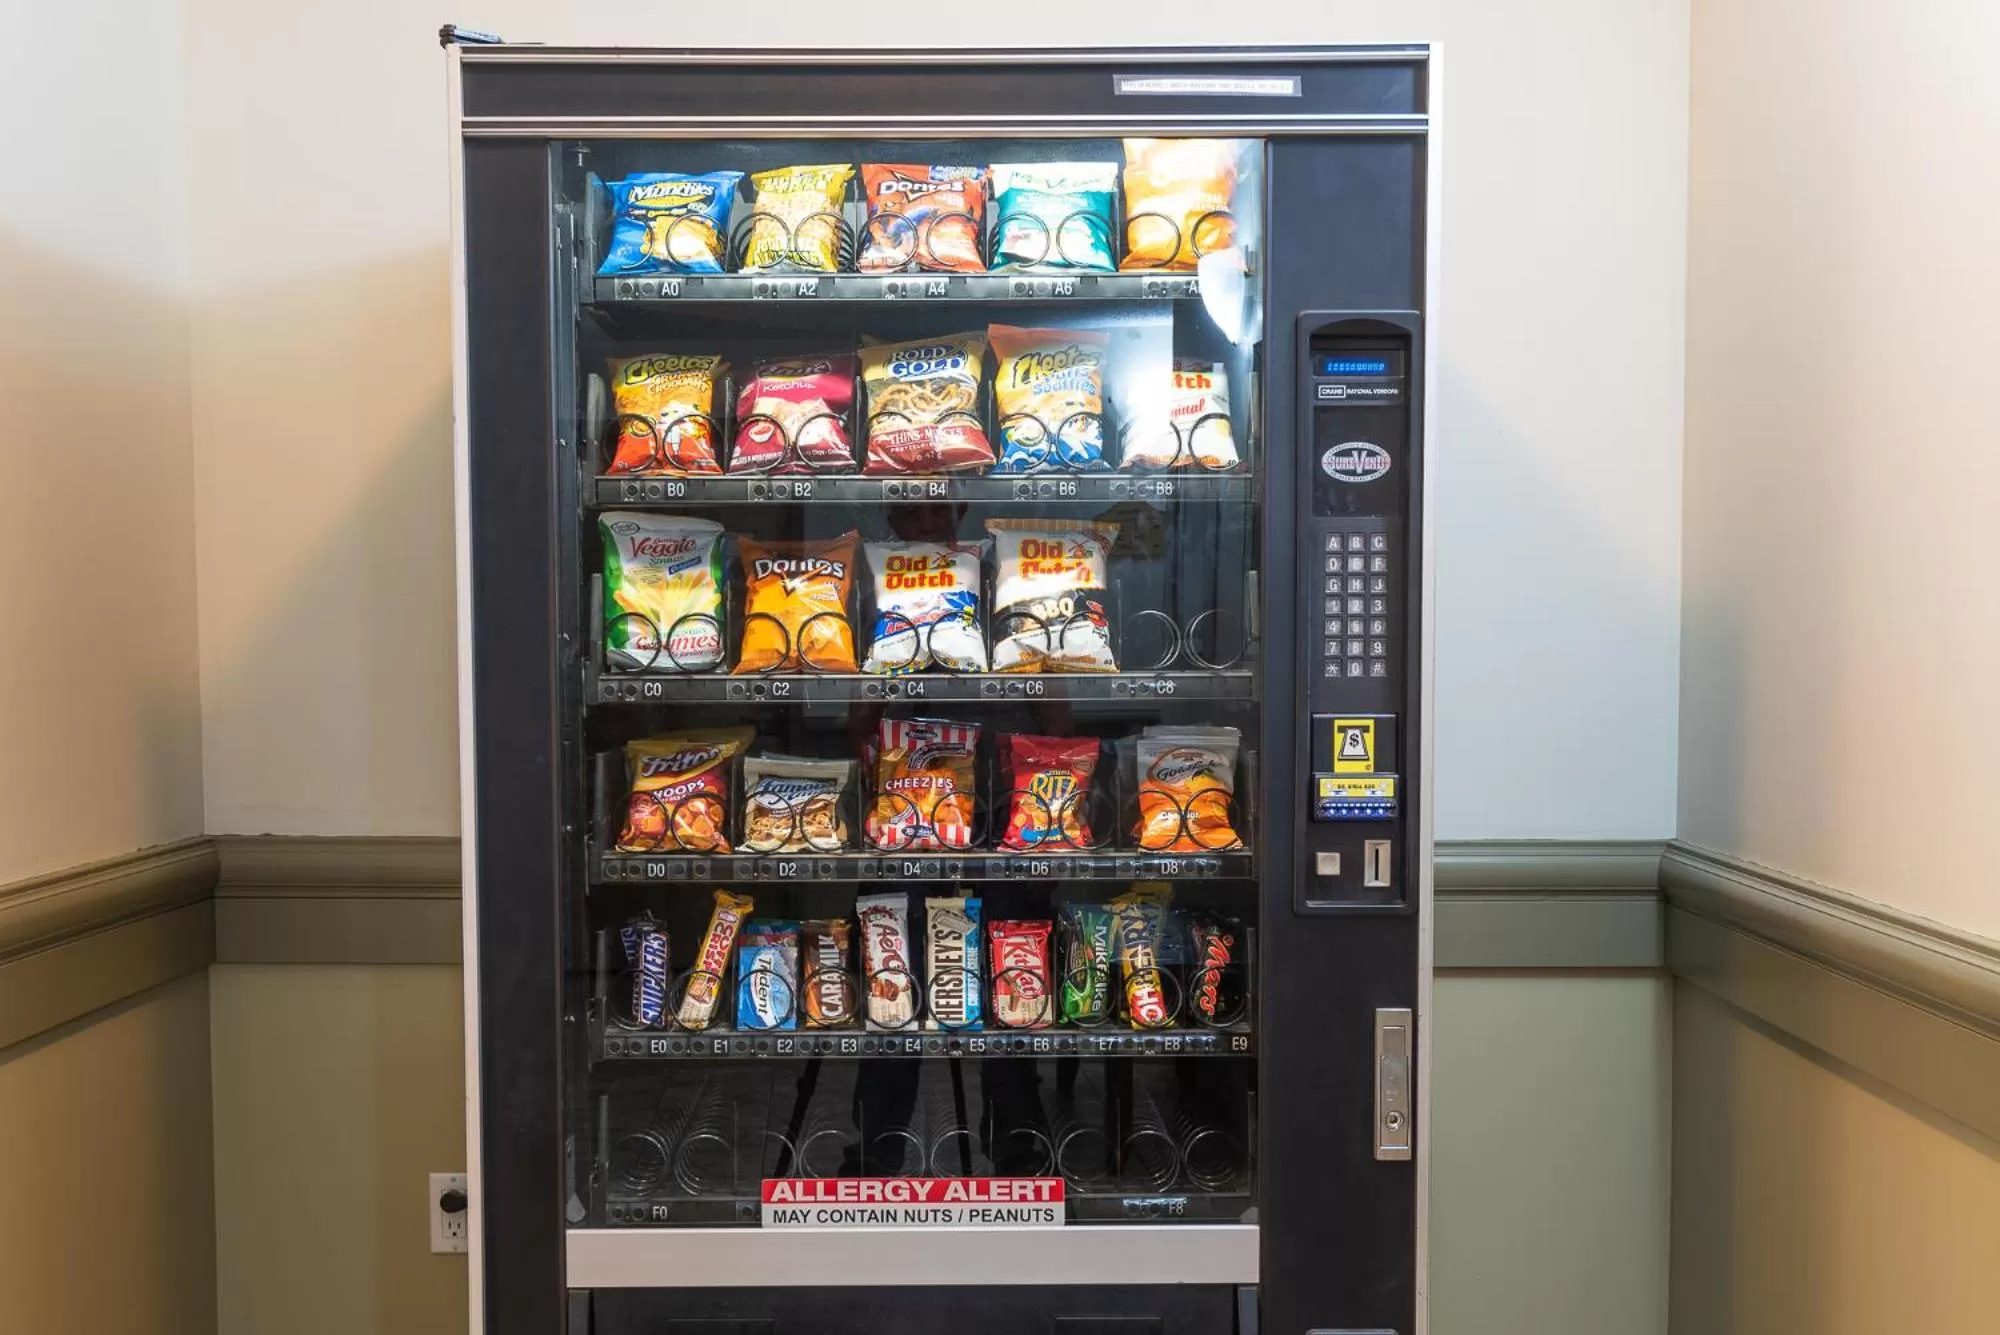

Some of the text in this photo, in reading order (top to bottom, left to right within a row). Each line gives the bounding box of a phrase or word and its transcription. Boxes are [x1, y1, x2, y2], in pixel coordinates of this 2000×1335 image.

[662, 282, 680, 296] A0
[798, 282, 816, 296] A2
[928, 282, 945, 296] A4
[1054, 282, 1072, 296] A6
[892, 347, 945, 362] ROLD
[888, 357, 965, 376] GOLD
[667, 483, 684, 497] B0
[795, 483, 812, 496] B2
[929, 483, 946, 496] B4
[1059, 482, 1076, 496] B6
[1156, 481, 1173, 495] B8
[629, 536, 697, 558] Veggie
[1021, 539, 1063, 559] Old
[755, 557, 845, 579] Doritos
[886, 555, 928, 571] Old
[885, 570, 955, 591] Dutch
[644, 683, 662, 696] C0
[772, 682, 790, 696] C2
[907, 681, 924, 695] C4
[1026, 681, 1043, 694] C6
[1157, 681, 1174, 694] C8
[1030, 773, 1077, 802] RITZ
[647, 863, 665, 876] D0
[780, 862, 797, 876] D2
[904, 862, 921, 875] D4
[1031, 862, 1048, 875] D6
[1161, 861, 1178, 875] D8
[702, 922, 723, 967] CRISP
[871, 922, 909, 975] Aero
[706, 923, 734, 989] COFFEE
[641, 932, 667, 1024] SNICKERS
[817, 934, 845, 1017] CARAMILK
[933, 928, 964, 1021] HERSHEY'S
[1200, 935, 1231, 1016] Mars
[757, 955, 773, 1014] Trident
[651, 1039, 667, 1052] E0
[714, 1039, 729, 1052] E1
[777, 1038, 793, 1052] E2
[841, 1038, 857, 1052] E3
[906, 1038, 921, 1052] E4
[970, 1038, 985, 1051] E5
[1034, 1038, 1049, 1051] E6
[1100, 1038, 1115, 1050] E7
[1164, 1037, 1180, 1050] E8
[1232, 1037, 1248, 1050] E9
[770, 1180, 1057, 1202] ALLERGY ALERT
[652, 1206, 668, 1219] F0
[1169, 1201, 1184, 1215] F8
[773, 1208, 1055, 1223] MAY CONTAIN NUTS / PEANUTS
